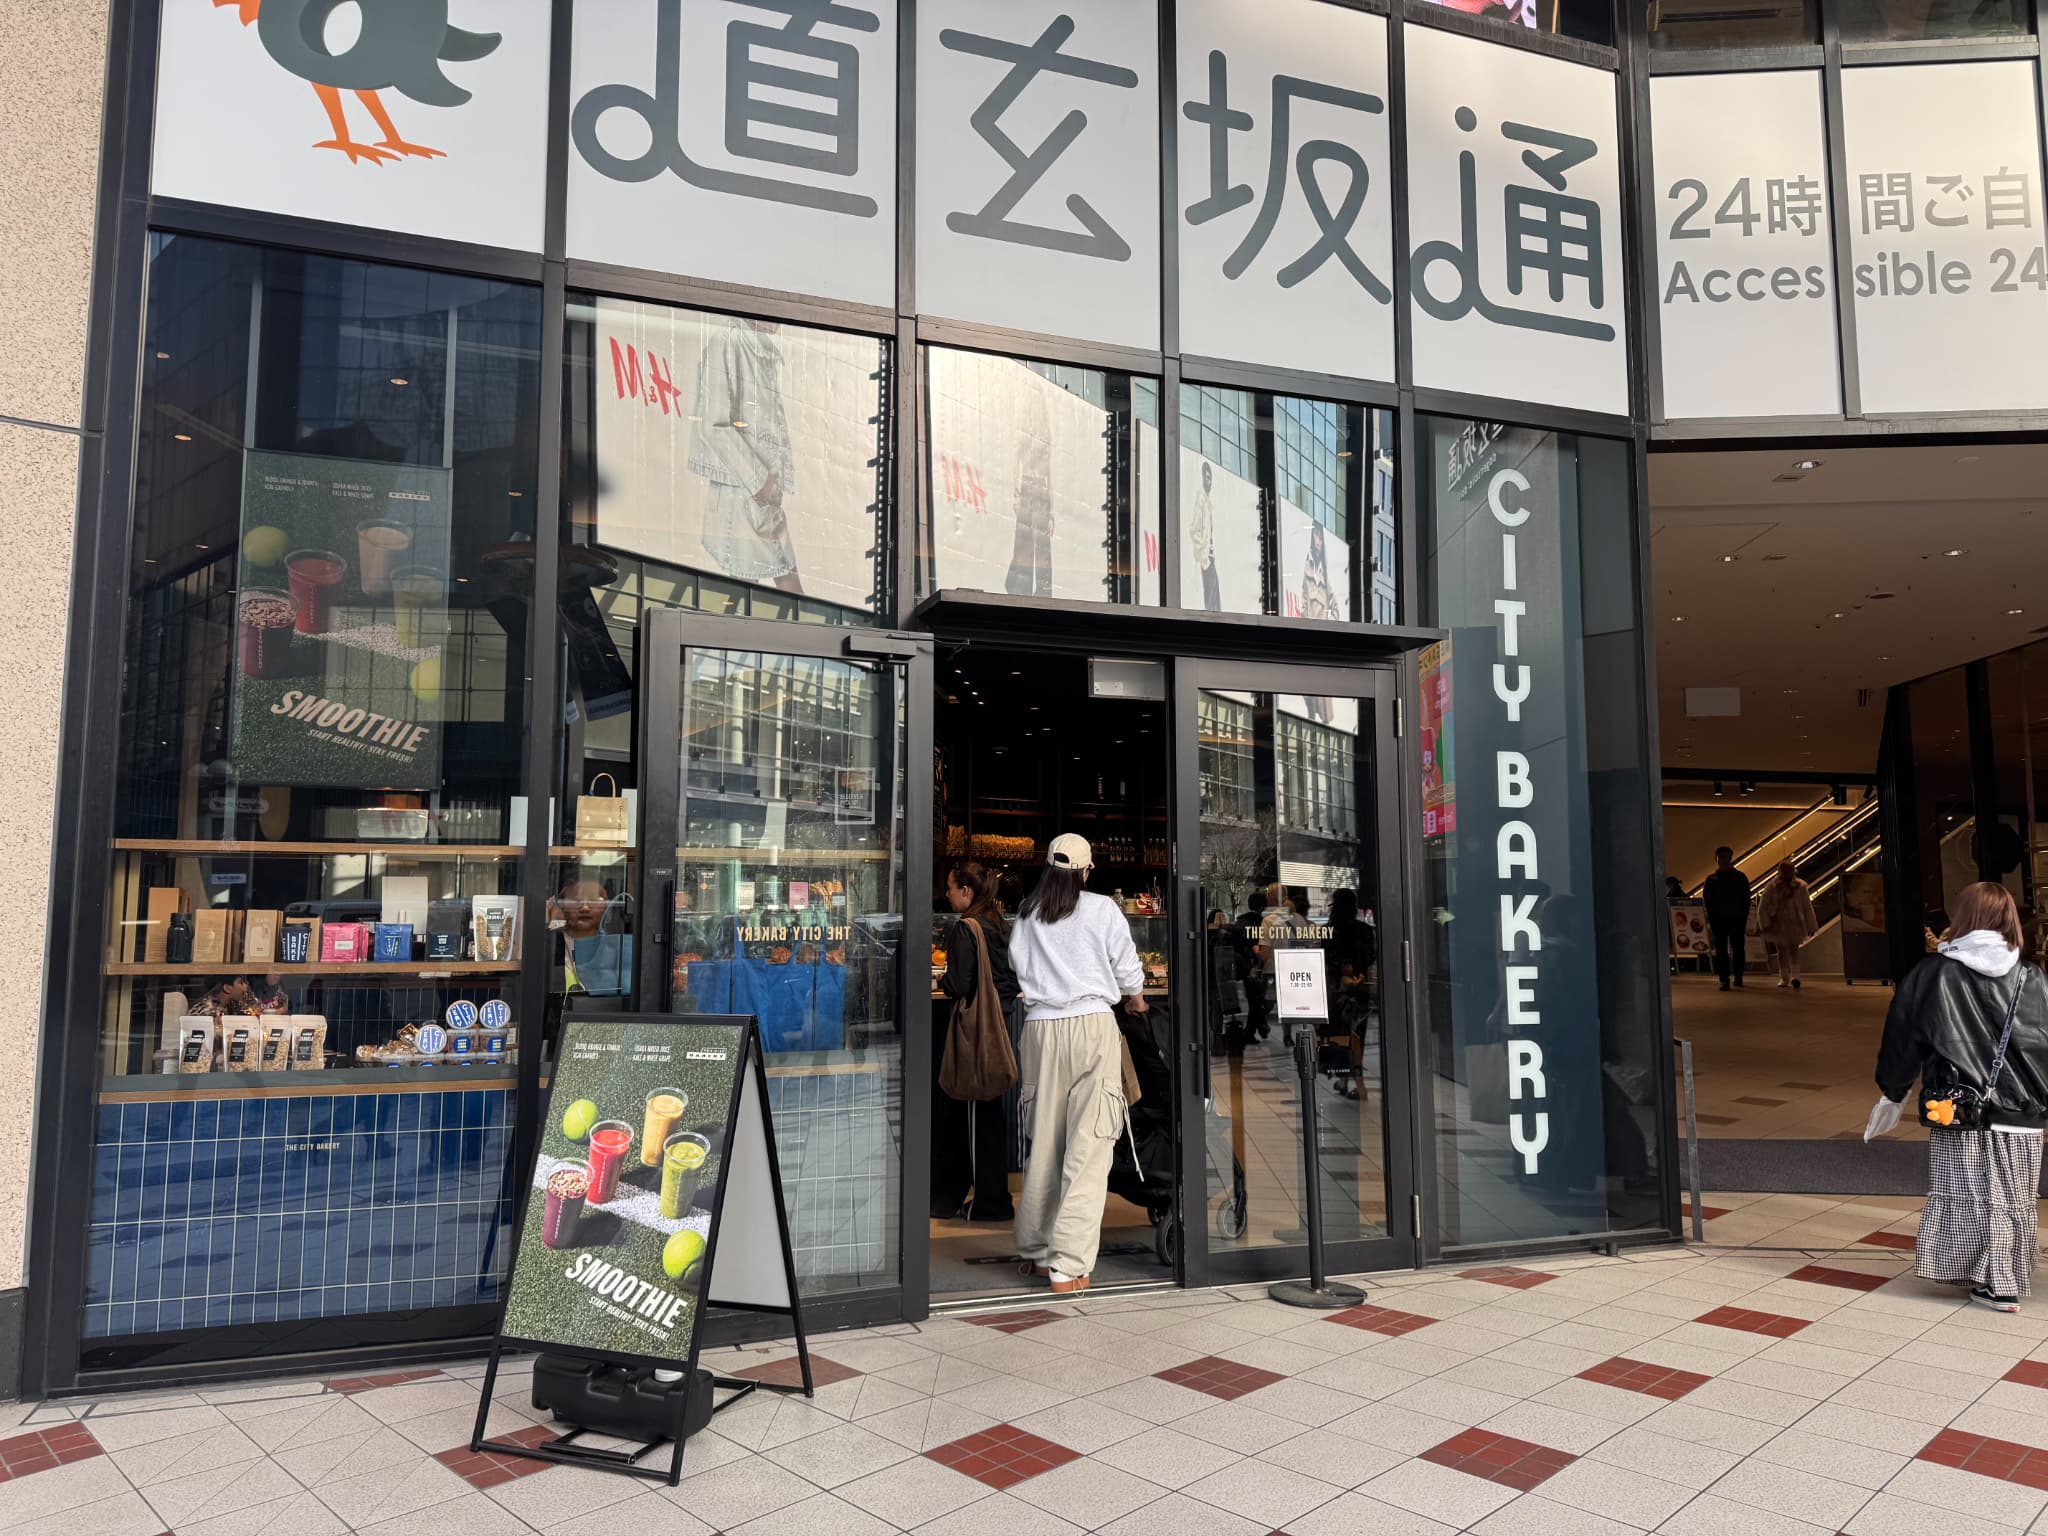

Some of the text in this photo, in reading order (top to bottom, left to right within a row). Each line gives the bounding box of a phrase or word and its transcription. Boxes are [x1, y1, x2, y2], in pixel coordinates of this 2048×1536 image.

[1667, 166, 2033, 240] 24時間ご自
[1664, 251, 1972, 304] Accessible
[270, 689, 430, 753] SMOOTHIE
[307, 729, 415, 764] START HEALTHY! STAY FRESH!
[1487, 467, 1550, 1175] CITY BAKERY
[1245, 925, 1335, 940] THE CITY BAKERY
[1289, 971, 1312, 983] OPEN
[564, 1252, 689, 1329] SMOOTHIE
[588, 1296, 609, 1310] START
[632, 1317, 650, 1330] STAY
